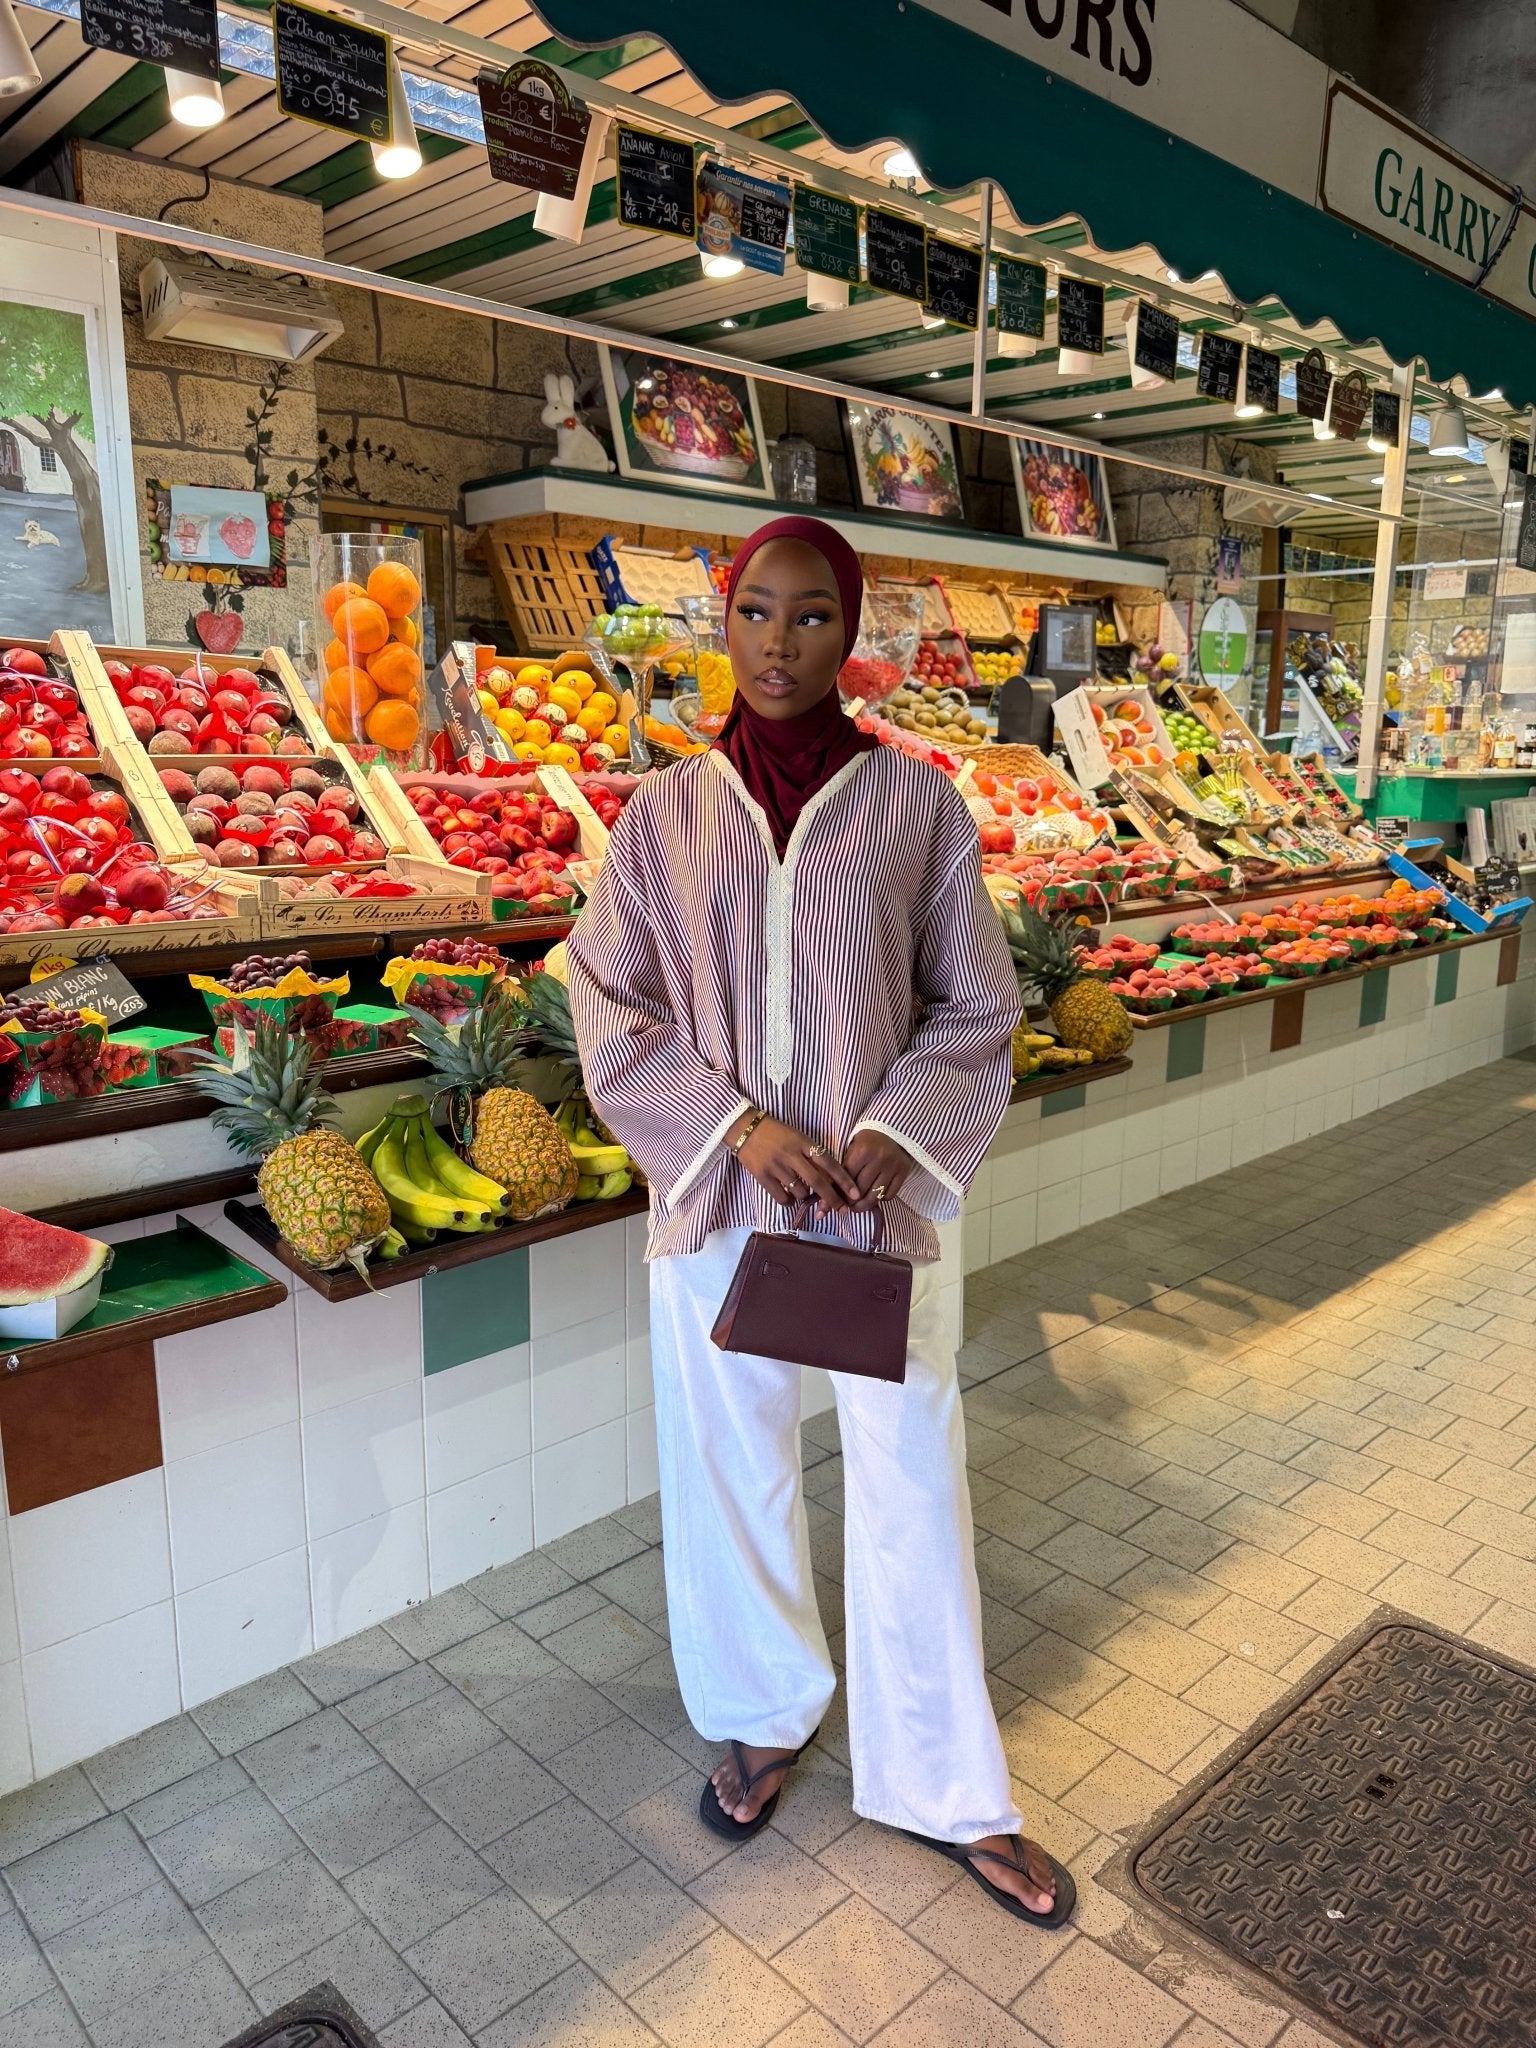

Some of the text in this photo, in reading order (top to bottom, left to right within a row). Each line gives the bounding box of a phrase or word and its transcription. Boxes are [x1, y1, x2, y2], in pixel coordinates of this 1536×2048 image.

[984, 0, 1155, 87] URS
[528, 81, 545, 97] 1kg
[539, 105, 552, 121] €
[370, 119, 384, 137] €
[484, 115, 508, 129] Produit
[621, 137, 656, 155] ANANAS
[716, 169, 776, 198] Garantir nos saveurs
[809, 195, 852, 219] GRENADE
[1375, 148, 1501, 269] GARRY
[682, 218, 692, 233] €
[848, 266, 857, 280] €
[315, 905, 342, 923] Les
[40, 960, 66, 975] 1kg
[63, 966, 108, 995] BLANC
[57, 998, 74, 1011] sans
[123, 998, 144, 1014] 203
